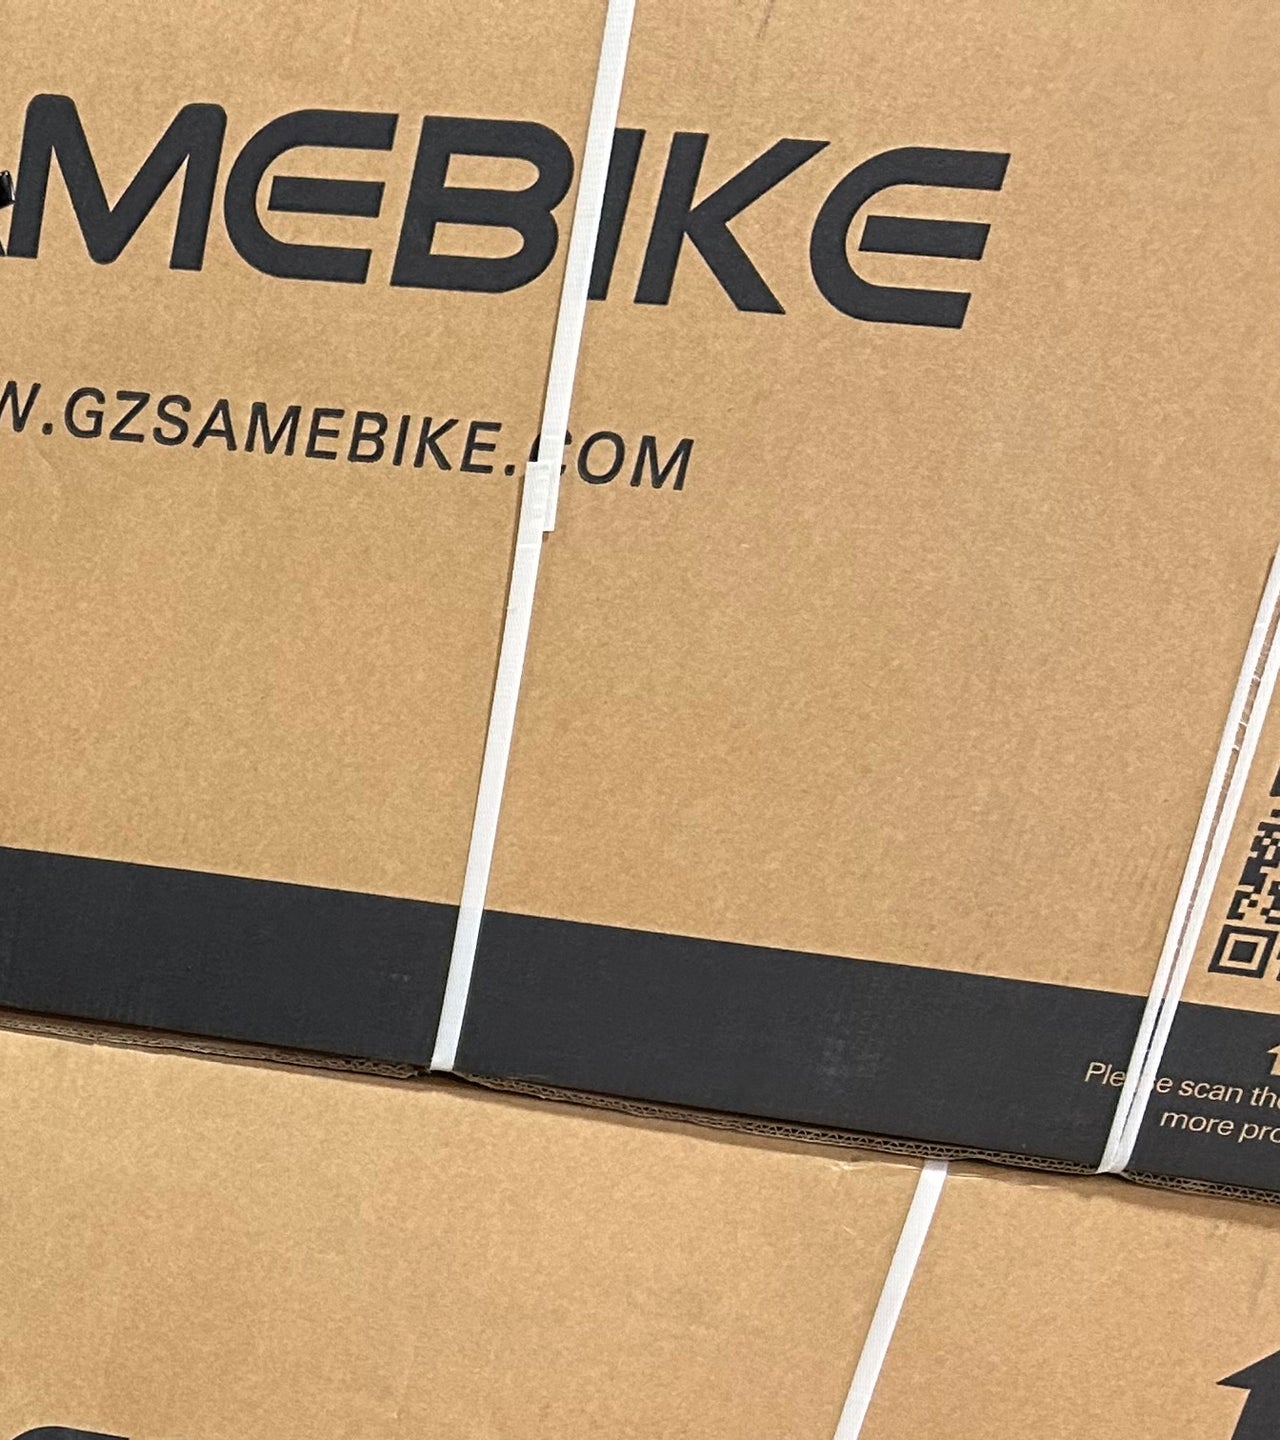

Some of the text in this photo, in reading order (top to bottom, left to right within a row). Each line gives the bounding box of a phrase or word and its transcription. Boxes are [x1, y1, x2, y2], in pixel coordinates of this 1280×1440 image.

[1084, 1061, 1174, 1094] Plee
[1178, 1079, 1244, 1104] scan
[1160, 1111, 1235, 1136] more
